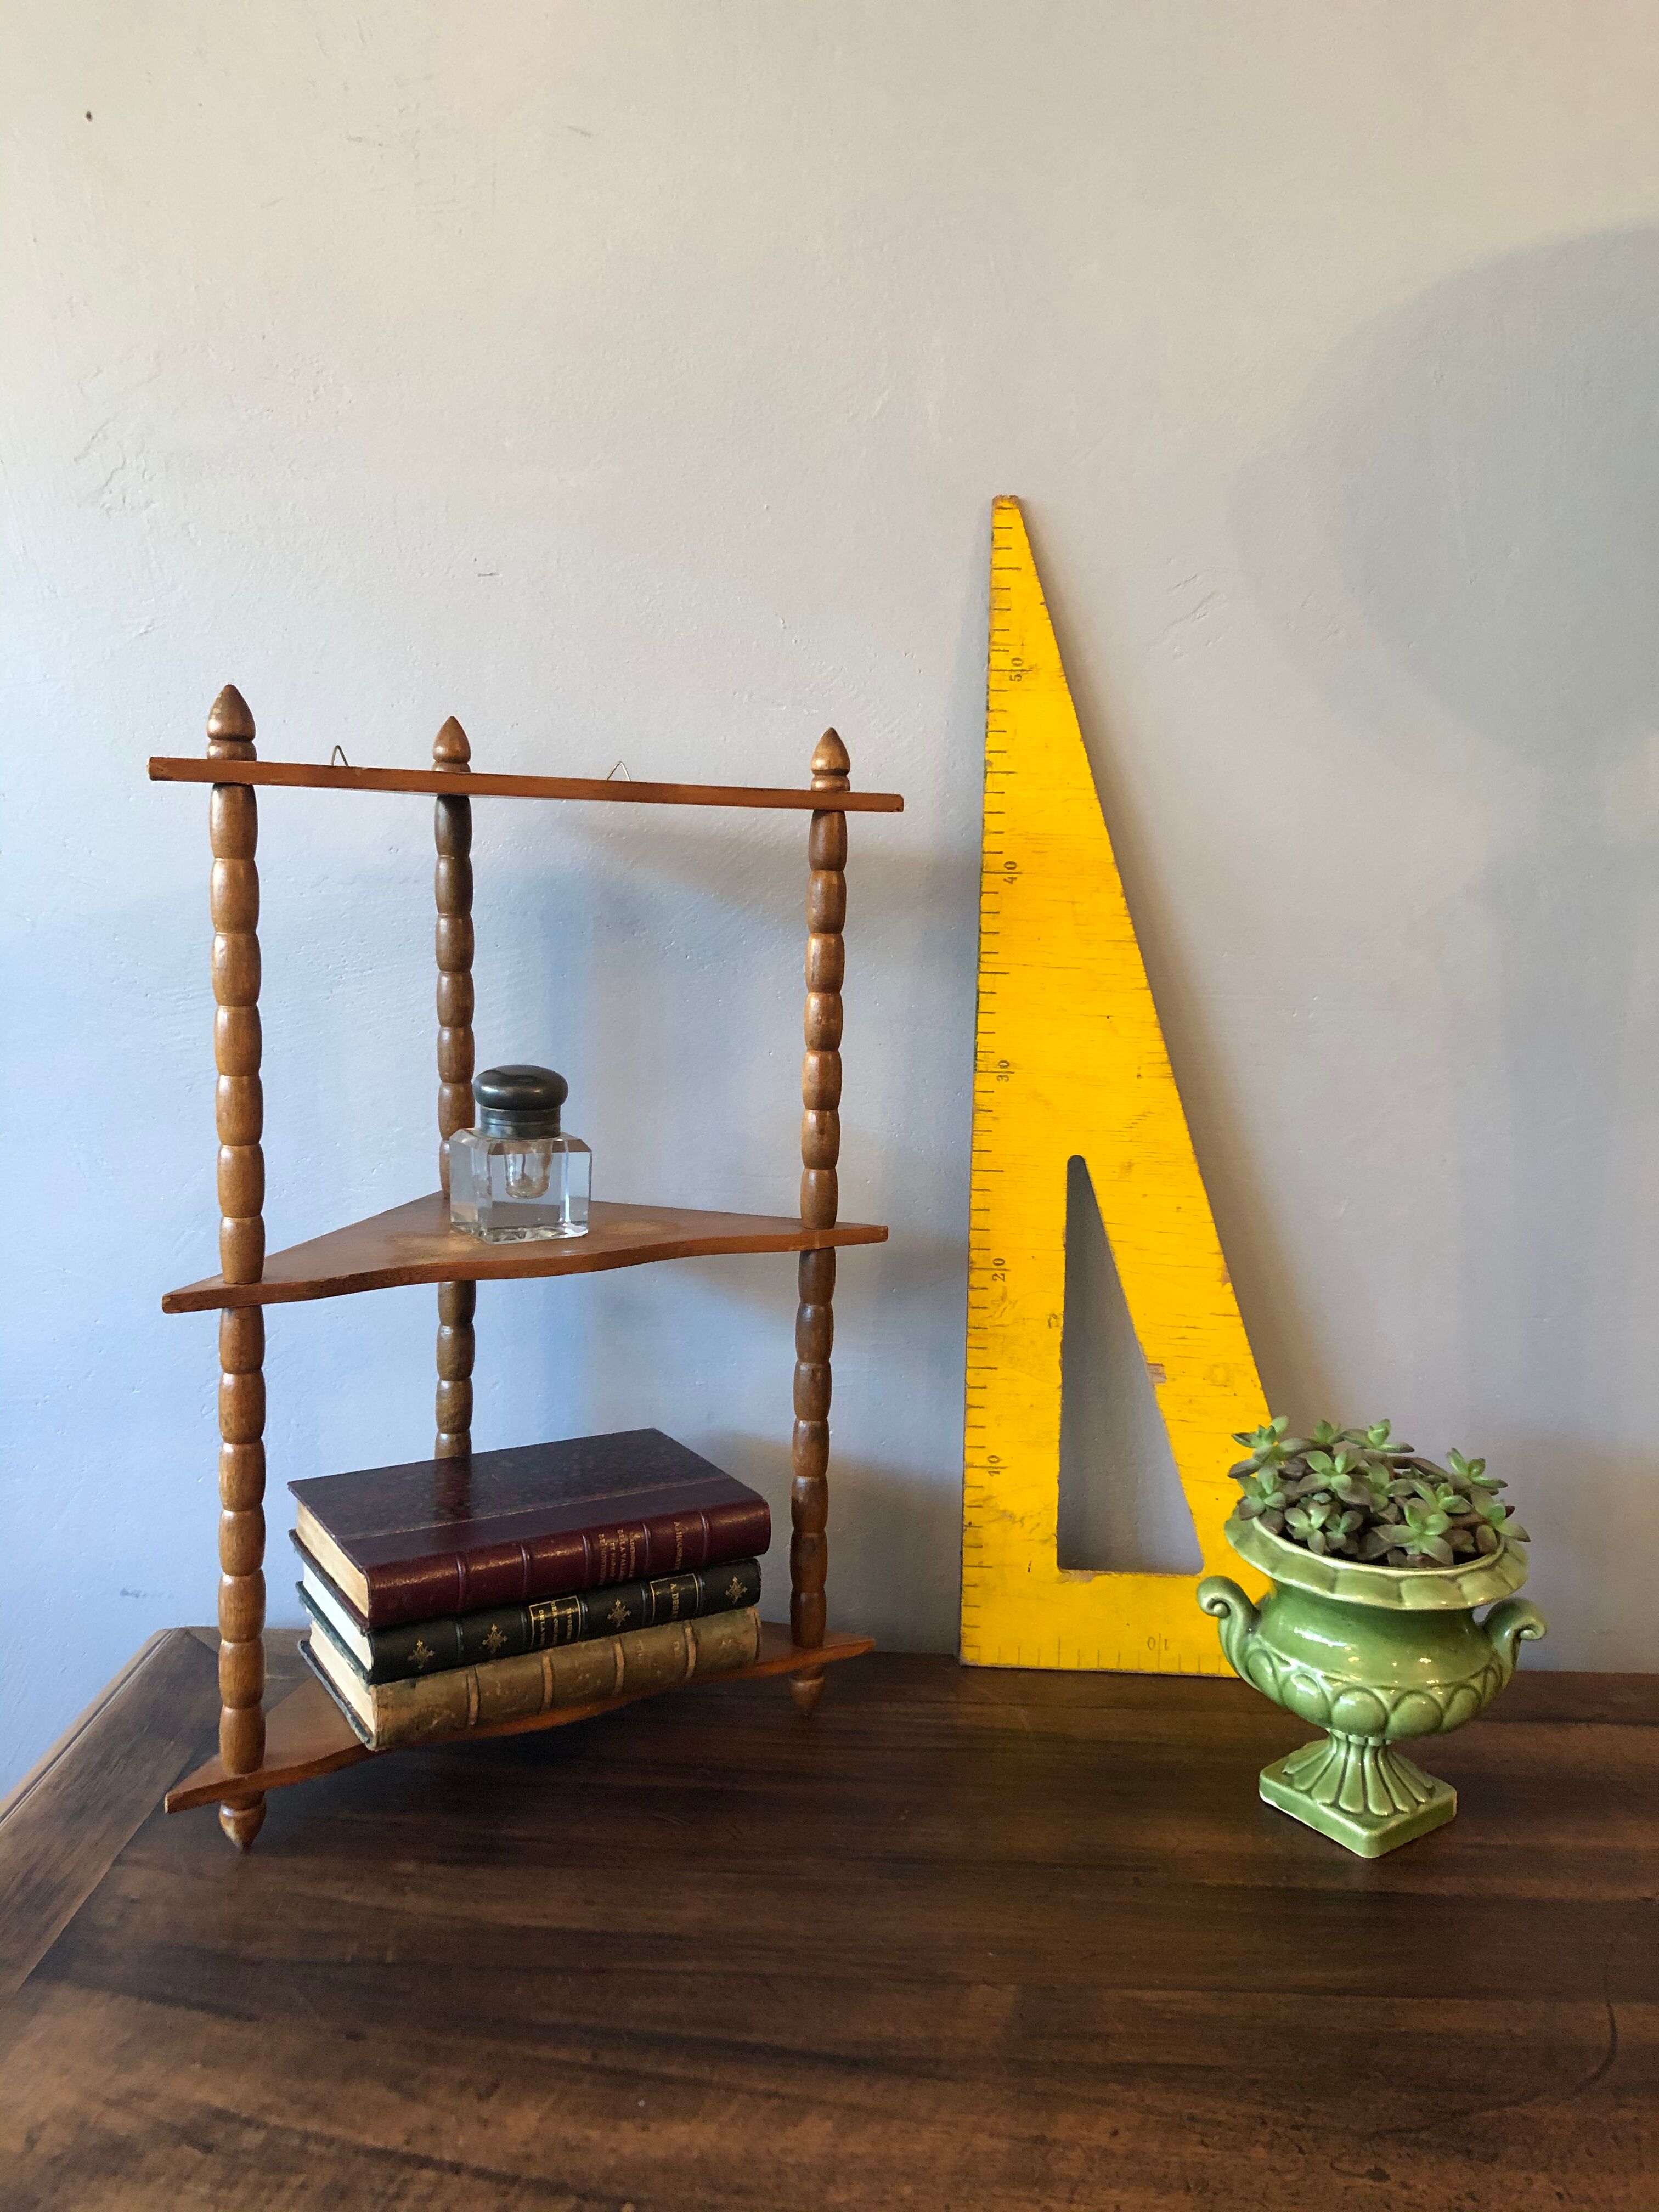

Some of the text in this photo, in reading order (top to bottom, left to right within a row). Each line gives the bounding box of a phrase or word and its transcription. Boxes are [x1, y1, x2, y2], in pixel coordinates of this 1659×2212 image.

[1009, 657, 1024, 682] 50
[1003, 861, 1018, 885] 40
[996, 1059, 1010, 1083] 30
[991, 1257, 1006, 1282] 20
[987, 1455, 1001, 1477] 10
